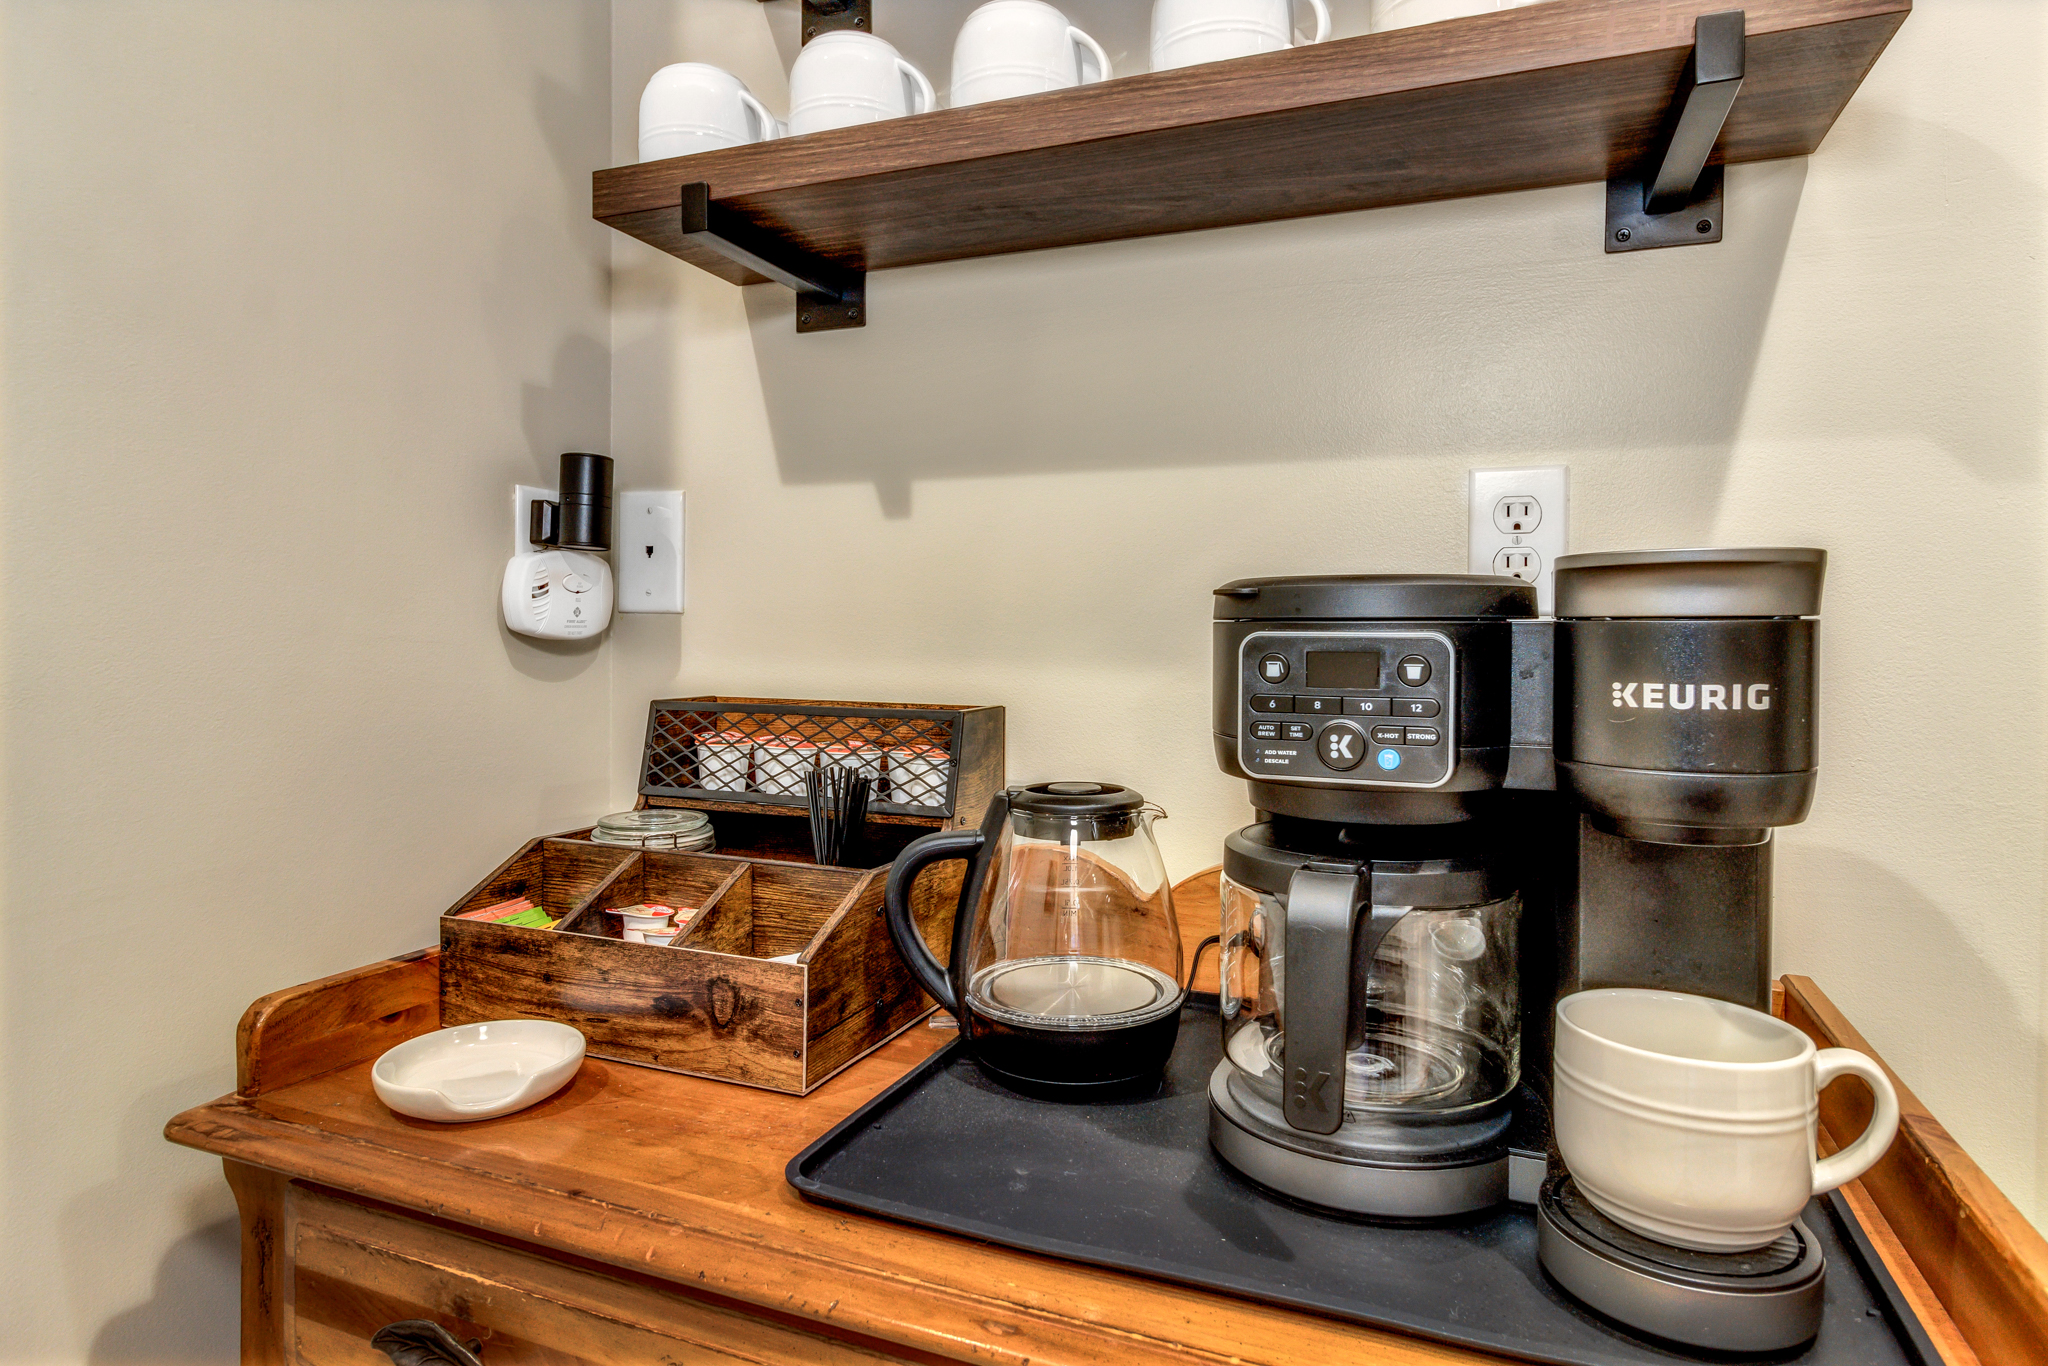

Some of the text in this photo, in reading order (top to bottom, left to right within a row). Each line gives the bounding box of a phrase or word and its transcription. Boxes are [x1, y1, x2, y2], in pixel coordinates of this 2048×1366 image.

[1612, 682, 1770, 710] KEURIG
[1269, 700, 1276, 708] 6
[1314, 701, 1321, 709] 8
[1360, 702, 1372, 711] 10
[1411, 704, 1422, 712] 12
